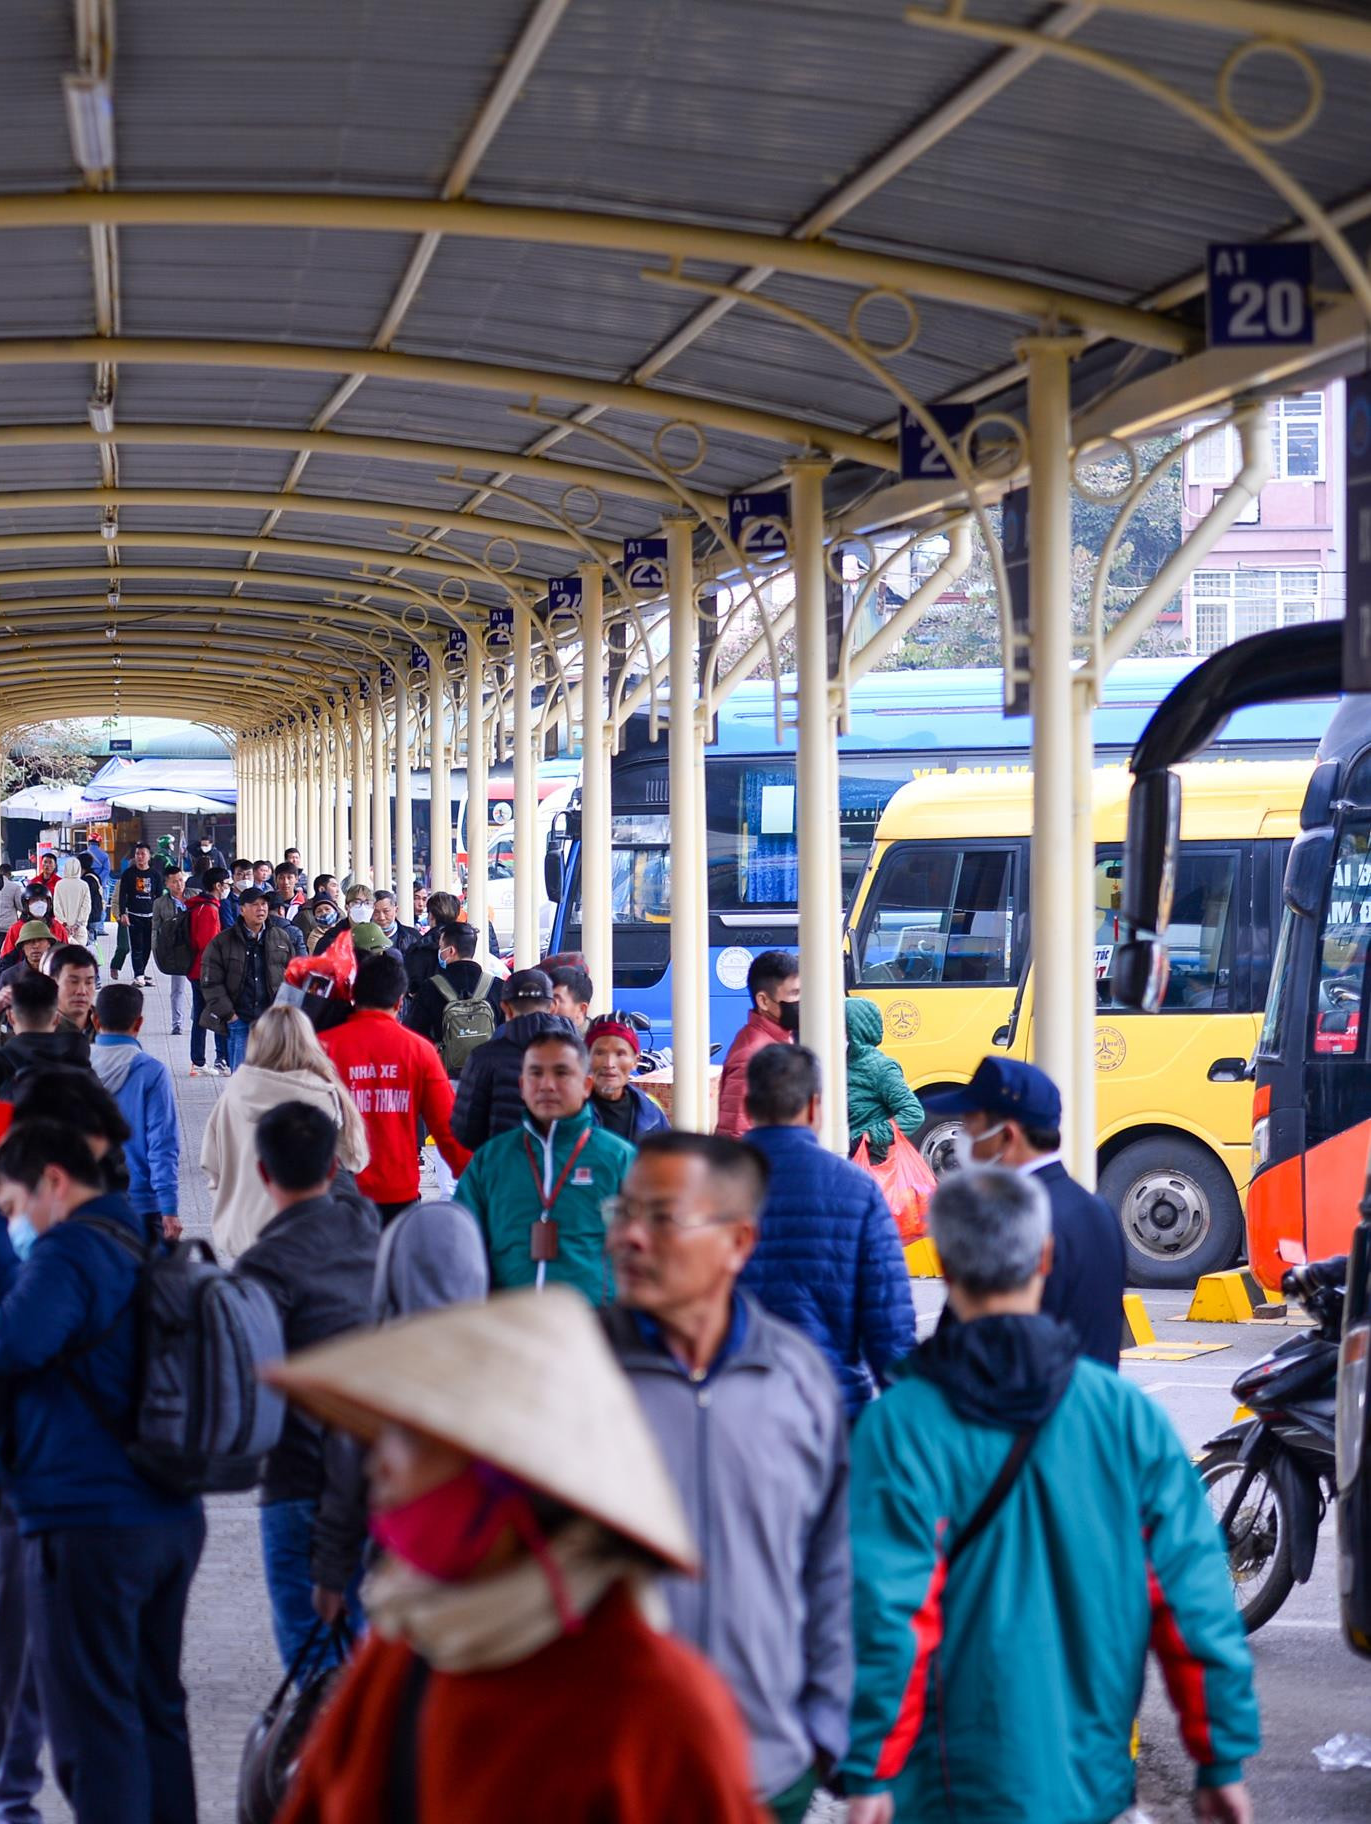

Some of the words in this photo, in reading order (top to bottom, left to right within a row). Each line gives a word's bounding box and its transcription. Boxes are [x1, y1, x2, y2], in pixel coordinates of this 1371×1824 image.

[1215, 251, 1245, 275] A1
[1229, 281, 1303, 337] 20
[733, 498, 750, 513] A1
[627, 542, 642, 554] A1
[551, 581, 564, 591] A1
[492, 612, 503, 621] A1
[451, 632, 461, 641] A1
[349, 1062, 376, 1080] NHÀ
[380, 1064, 398, 1079] XE
[375, 1088, 410, 1113] THANH
